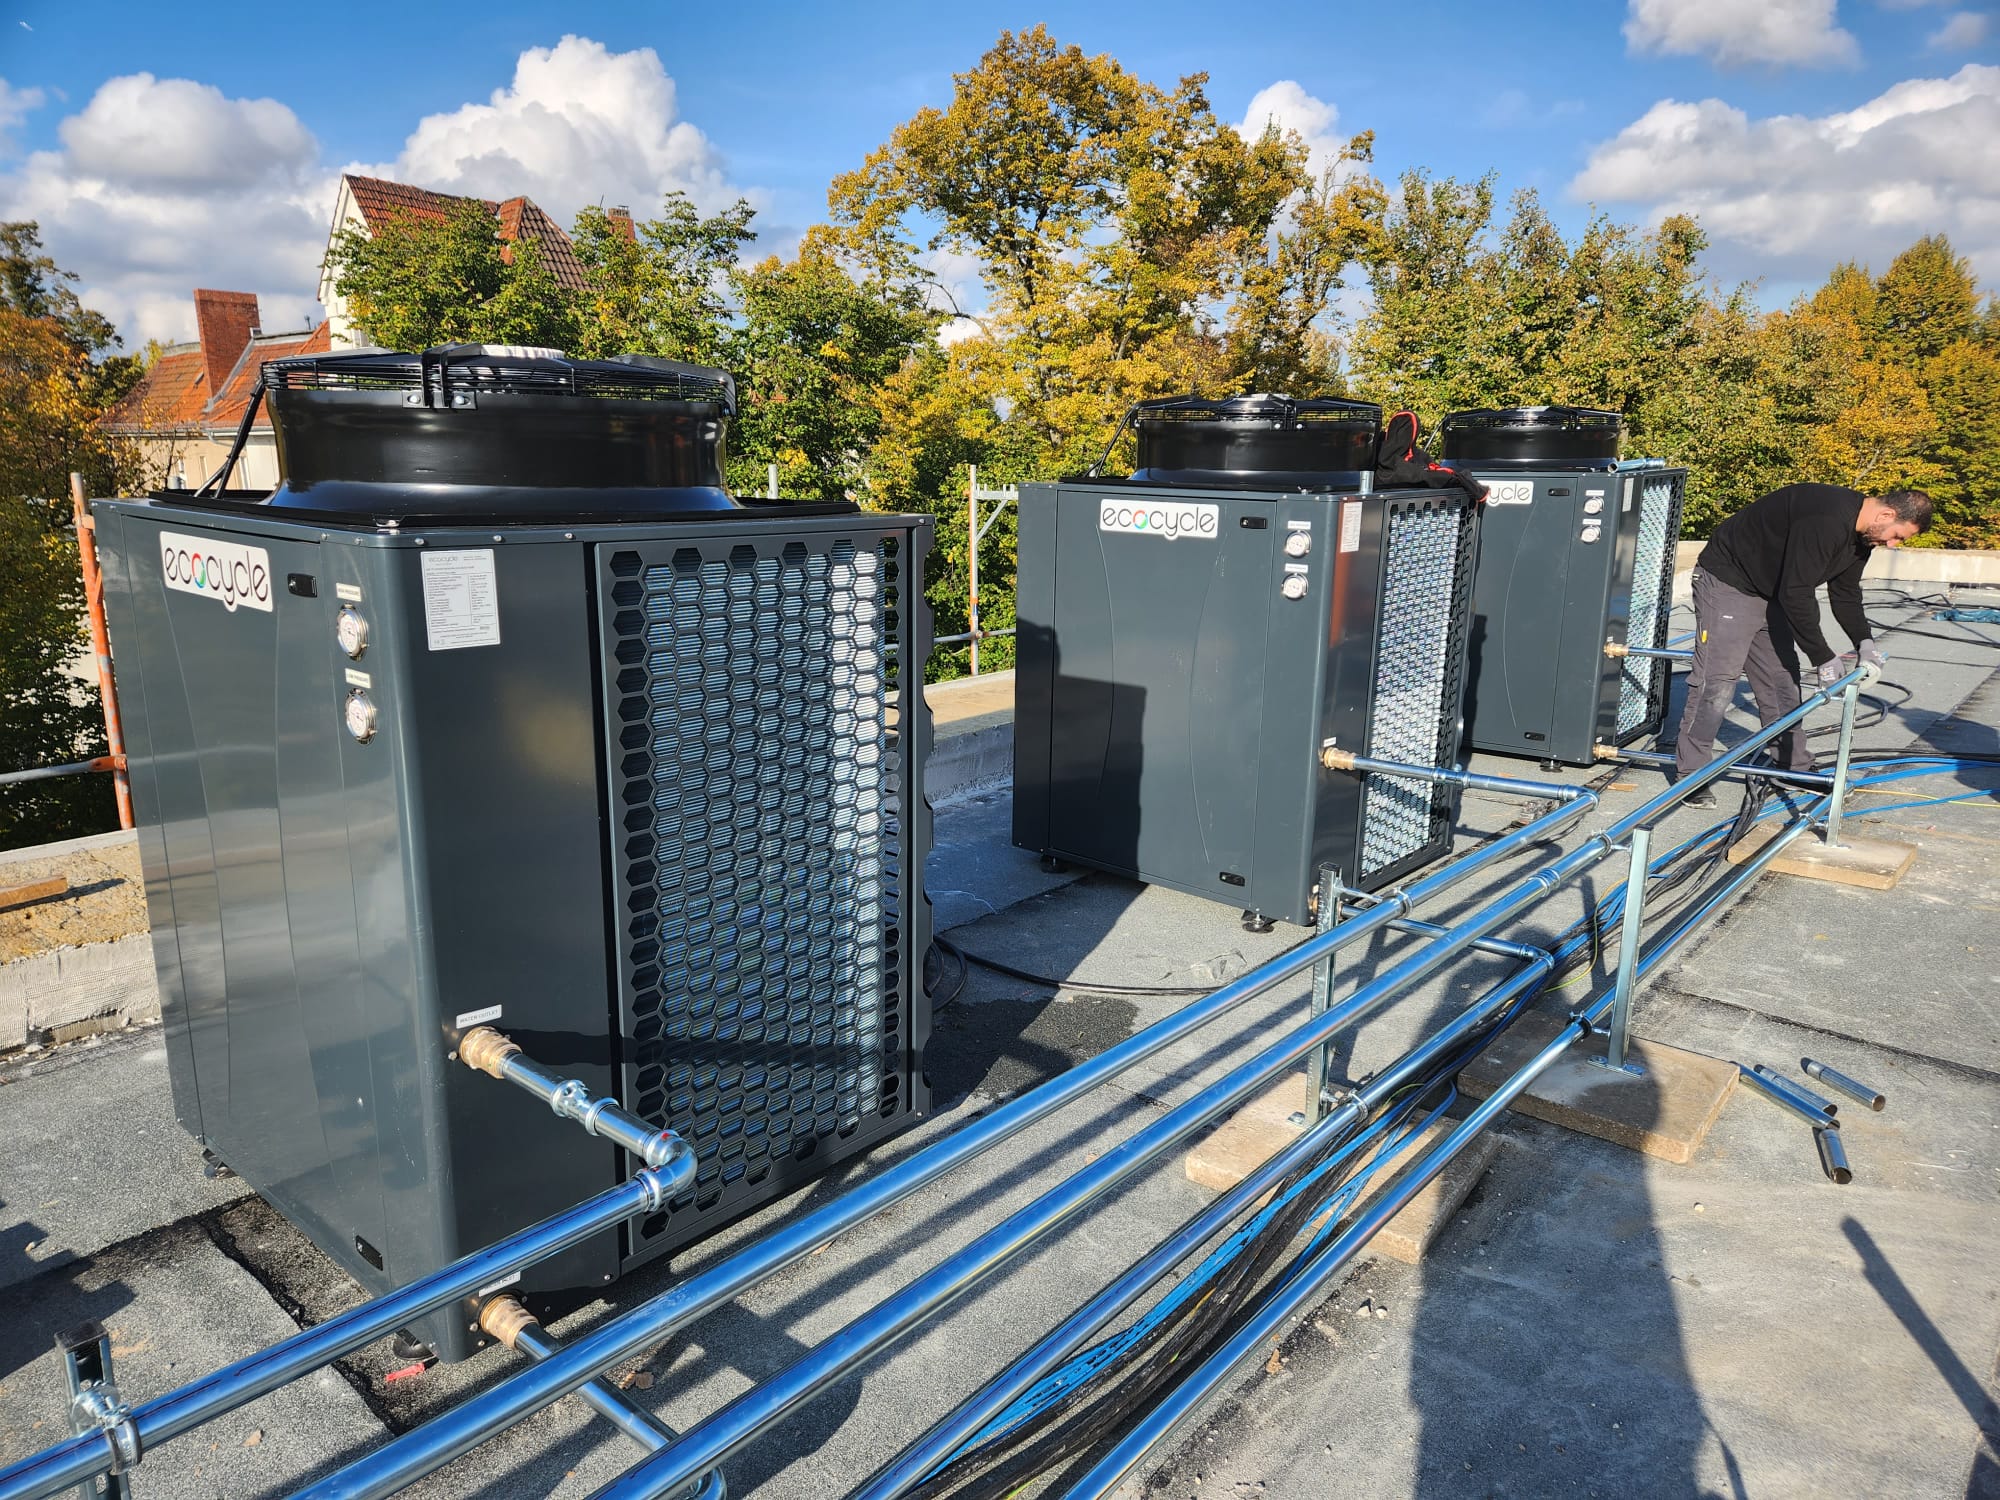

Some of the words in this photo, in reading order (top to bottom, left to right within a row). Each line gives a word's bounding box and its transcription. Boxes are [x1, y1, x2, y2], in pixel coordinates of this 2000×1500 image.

[1489, 482, 1530, 504] ycle
[1102, 506, 1216, 537] ecocycle
[164, 547, 269, 606] ecocycle
